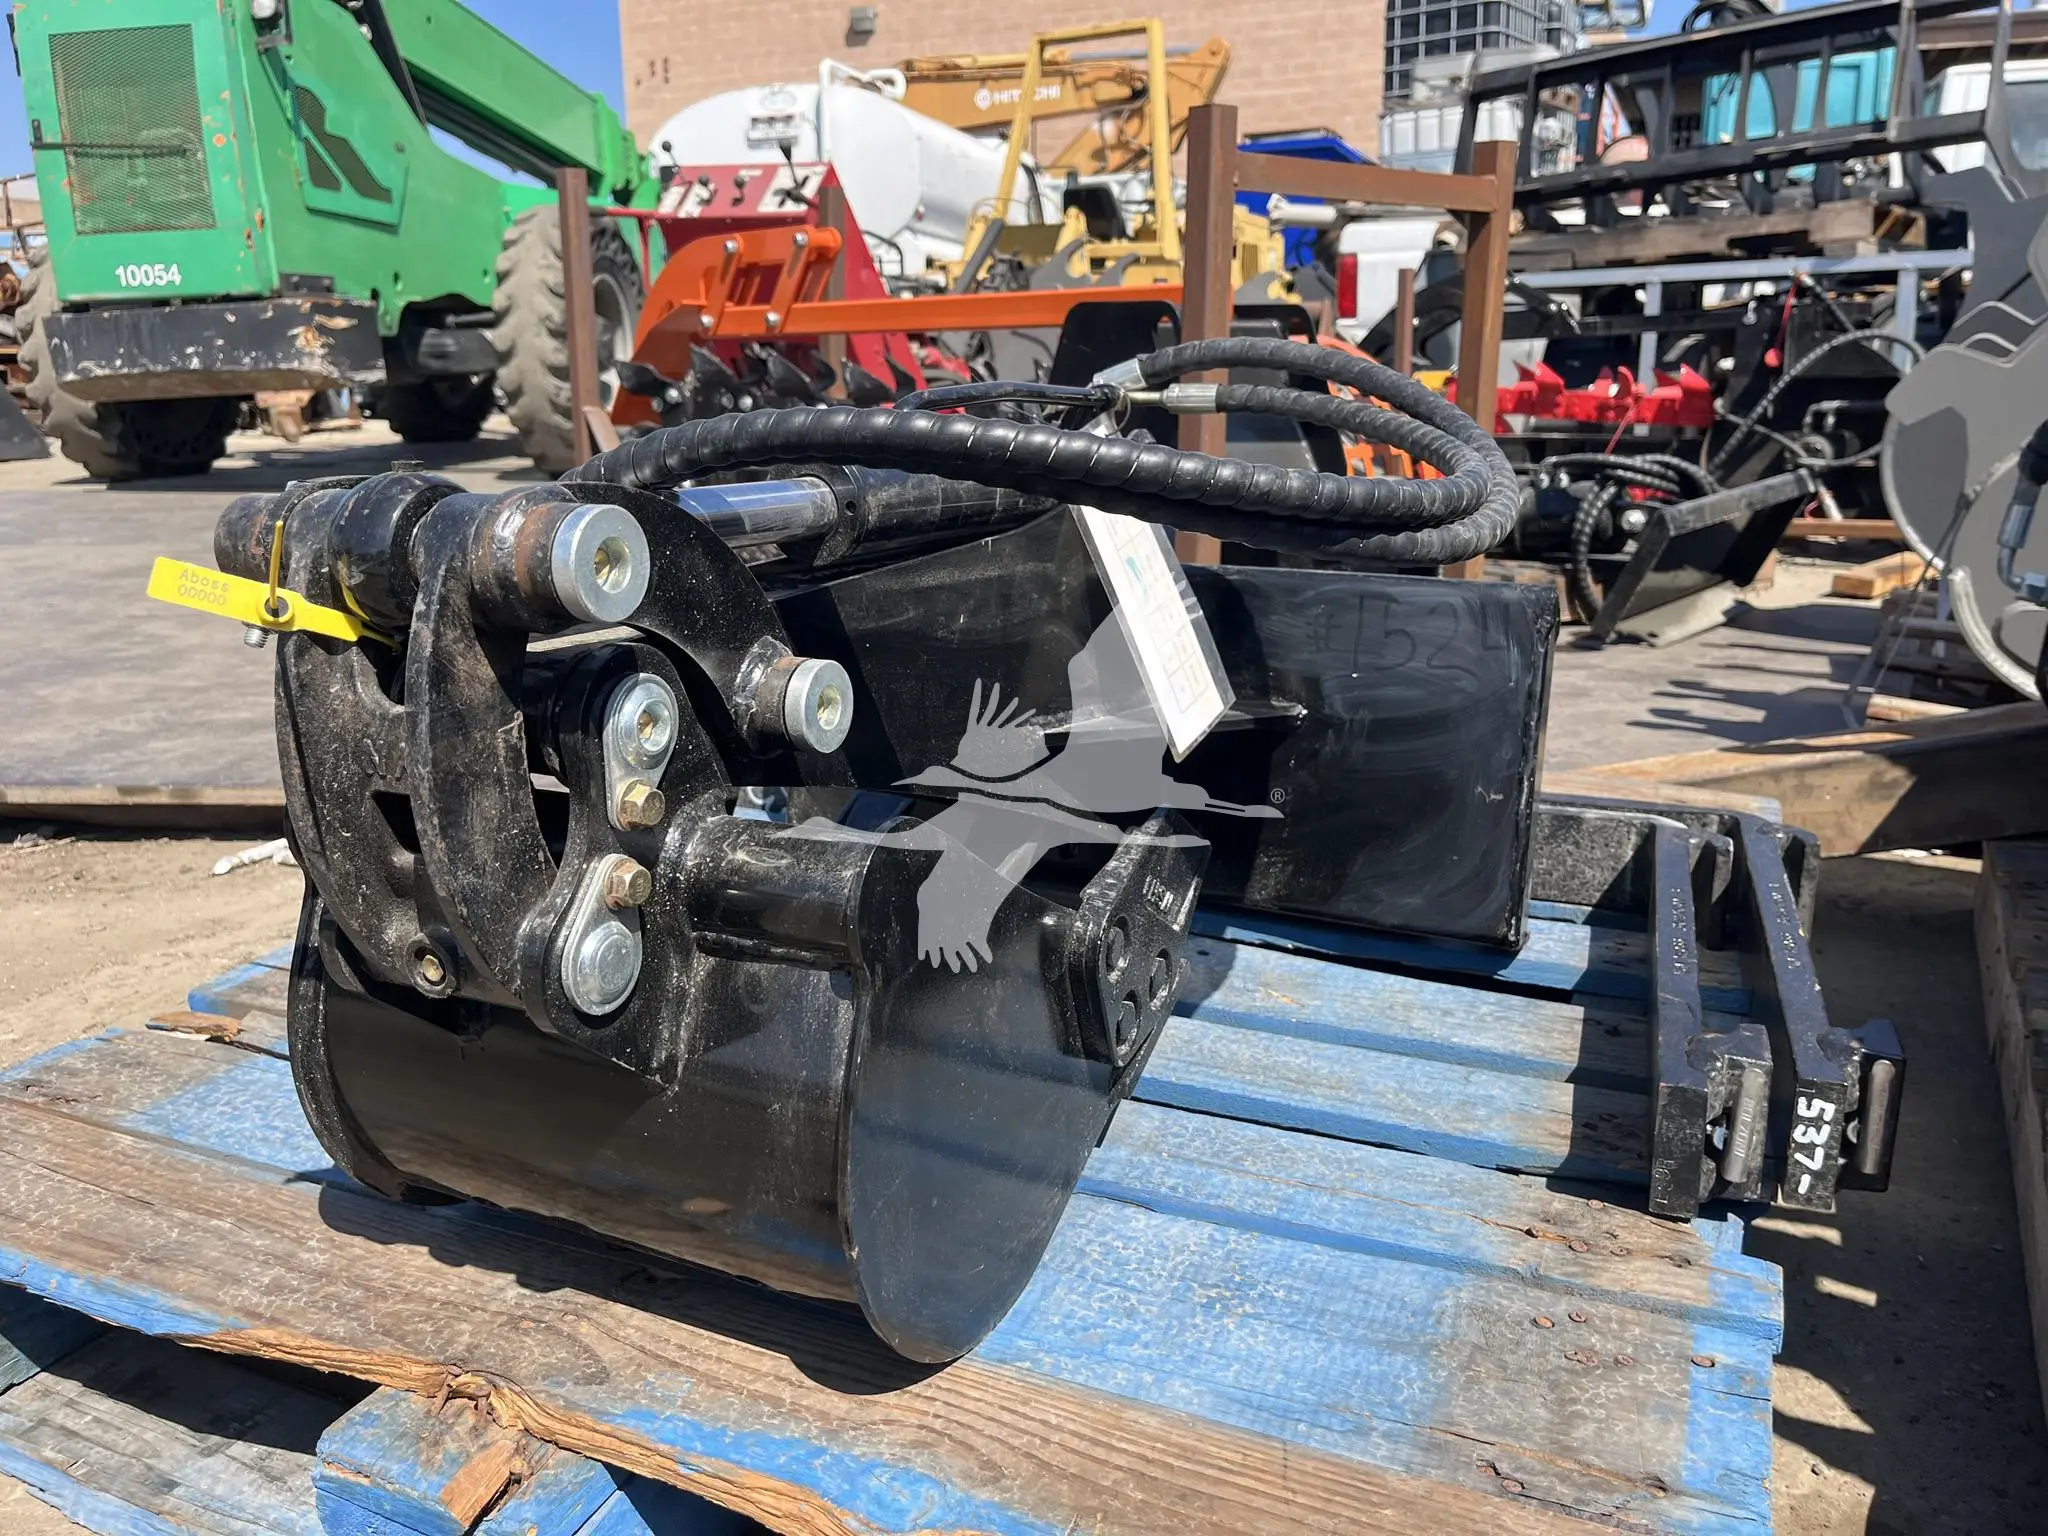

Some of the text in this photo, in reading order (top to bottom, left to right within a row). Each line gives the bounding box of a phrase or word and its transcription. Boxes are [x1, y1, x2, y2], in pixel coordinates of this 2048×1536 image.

[115, 263, 182, 287] 10054
[178, 567, 229, 593] Aboss
[177, 584, 227, 607] 00000
